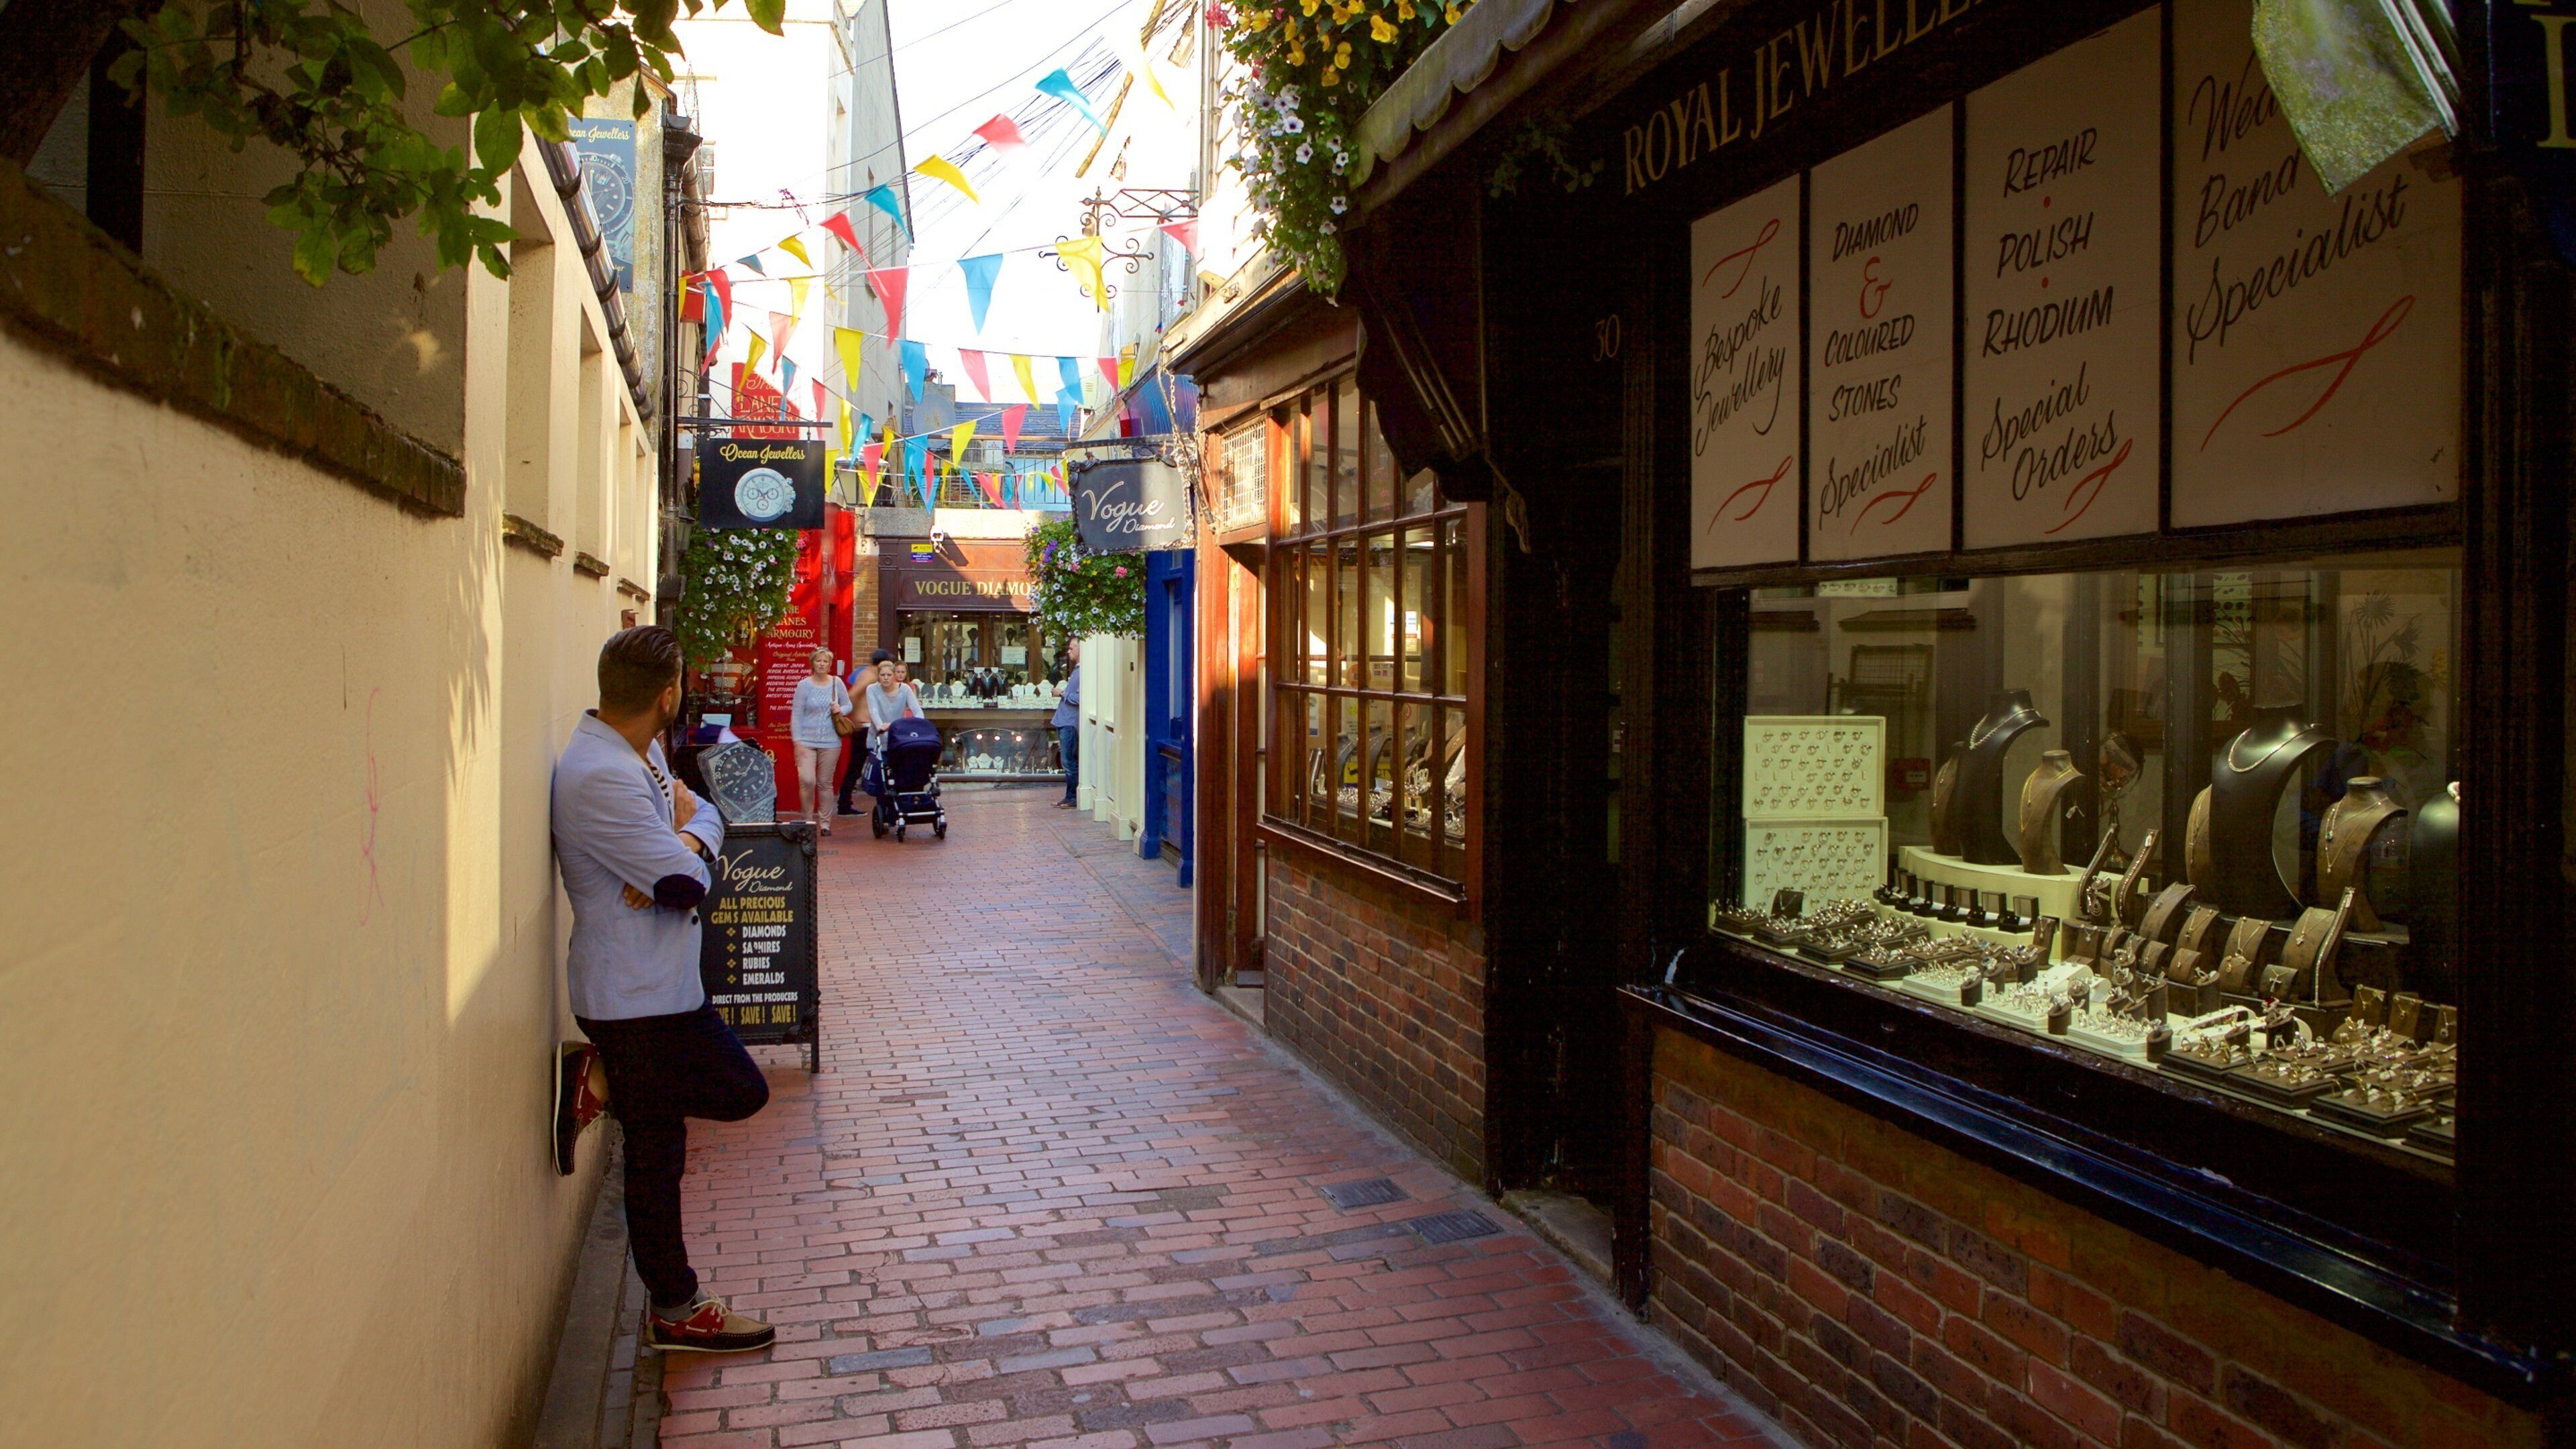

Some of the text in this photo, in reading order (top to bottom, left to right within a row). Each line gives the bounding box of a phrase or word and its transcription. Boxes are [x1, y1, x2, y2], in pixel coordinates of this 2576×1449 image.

[1623, 0, 1984, 197] ROYAL JEWELL
[568, 125, 630, 143] cean Jewellers
[2002, 127, 2097, 198] REPAIR
[1833, 203, 1919, 262] DIAMOND
[1997, 211, 2094, 278] POLISH
[1859, 256, 1893, 319] &
[2187, 173, 2408, 365] Specialist
[1592, 313, 1620, 362] 30
[1693, 275, 1782, 400] Bespoke
[1824, 314, 1915, 368] COLOURED
[1982, 286, 2113, 358] RHODIUM
[1695, 345, 1786, 458] Jewellery
[1829, 374, 1902, 423] STONES
[1980, 361, 2090, 472] Special
[719, 443, 806, 464] Ocean Jewellers
[1819, 415, 1928, 531] Specialist
[2011, 410, 2118, 501] Orders
[1081, 481, 1165, 533] Vogue
[1122, 517, 1176, 534] Diamond
[914, 580, 1035, 596] VOGUE DIAMO
[716, 849, 786, 892] Vogue
[748, 880, 793, 893] Diamond
[711, 910, 794, 924] GEMS AVAILABLE
[719, 896, 786, 910] ALL PRECIOUS
[743, 924, 786, 938] DIAMONDS
[743, 957, 770, 970] RUBIES
[743, 972, 785, 985] EMERALDS
[712, 991, 798, 1004] DIRECT FROM THE PRODUCERS
